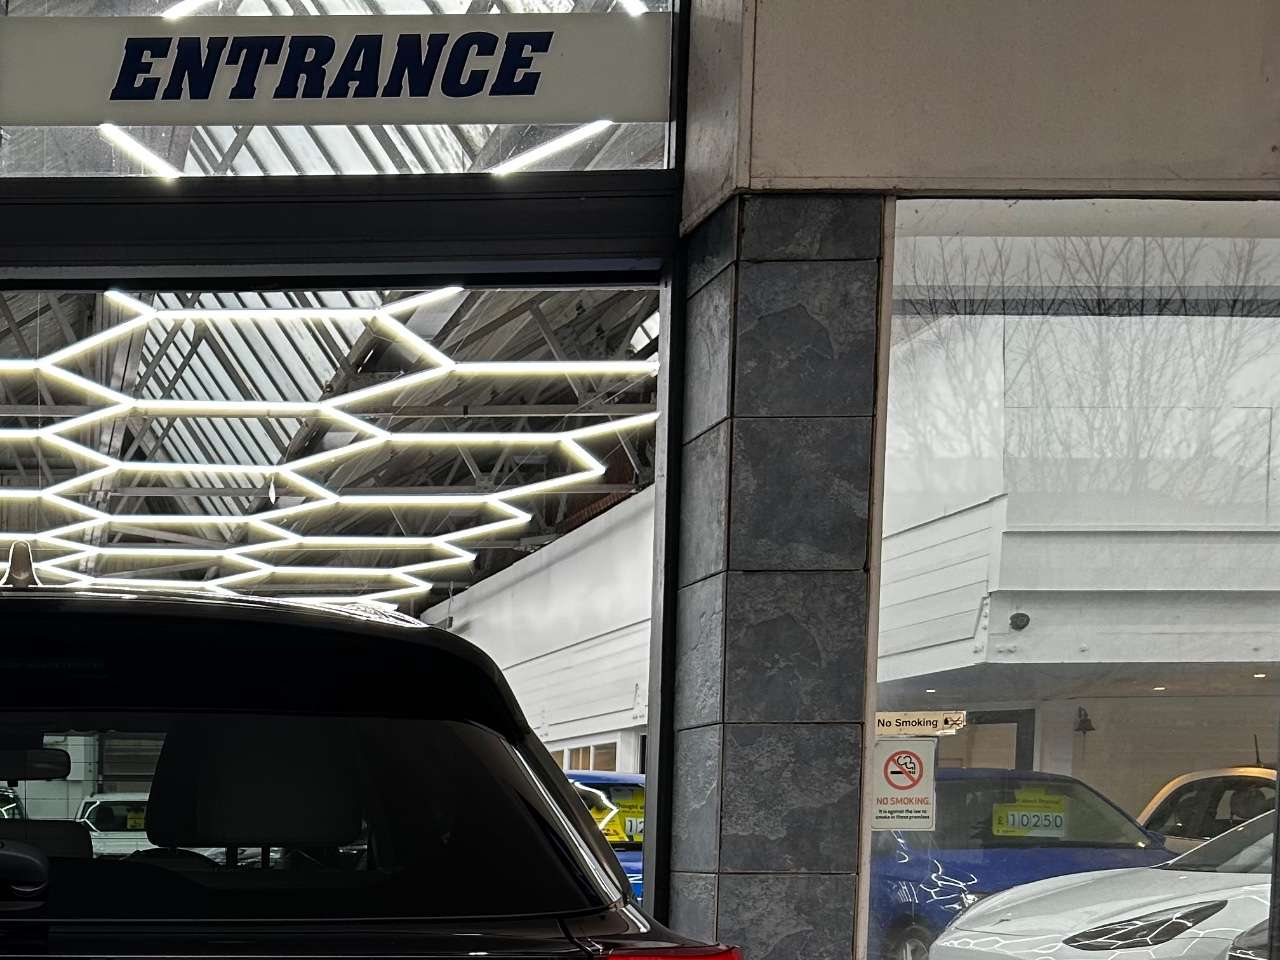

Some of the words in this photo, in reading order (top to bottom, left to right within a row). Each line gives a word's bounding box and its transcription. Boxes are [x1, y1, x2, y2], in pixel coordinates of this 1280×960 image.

[110, 31, 555, 101] ENTRANCE
[877, 719, 892, 728] No
[895, 718, 938, 729] Smoking
[876, 797, 889, 805] NO
[890, 797, 929, 805] SMOKING
